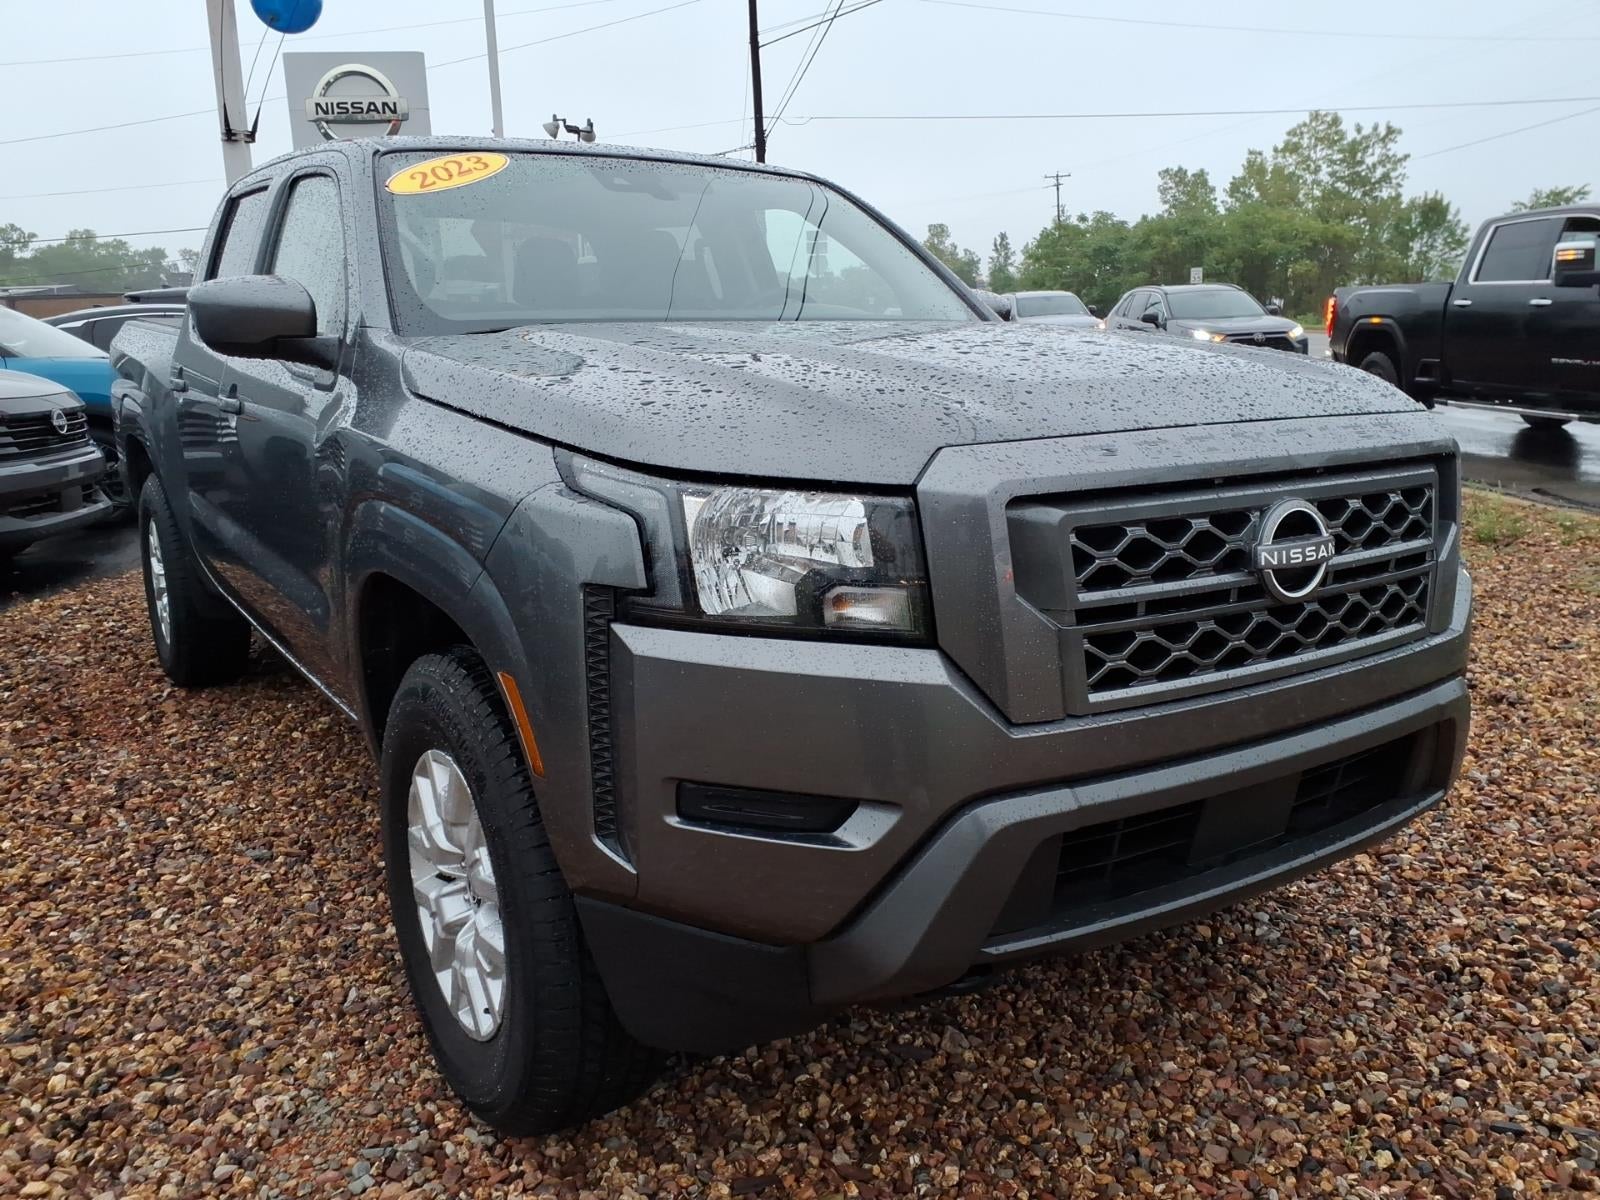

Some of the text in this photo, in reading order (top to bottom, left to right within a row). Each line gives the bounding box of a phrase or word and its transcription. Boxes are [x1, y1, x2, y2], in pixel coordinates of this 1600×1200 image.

[315, 101, 398, 116] NISSAN
[409, 156, 489, 189] 2023
[1261, 542, 1335, 566] NISSAN
